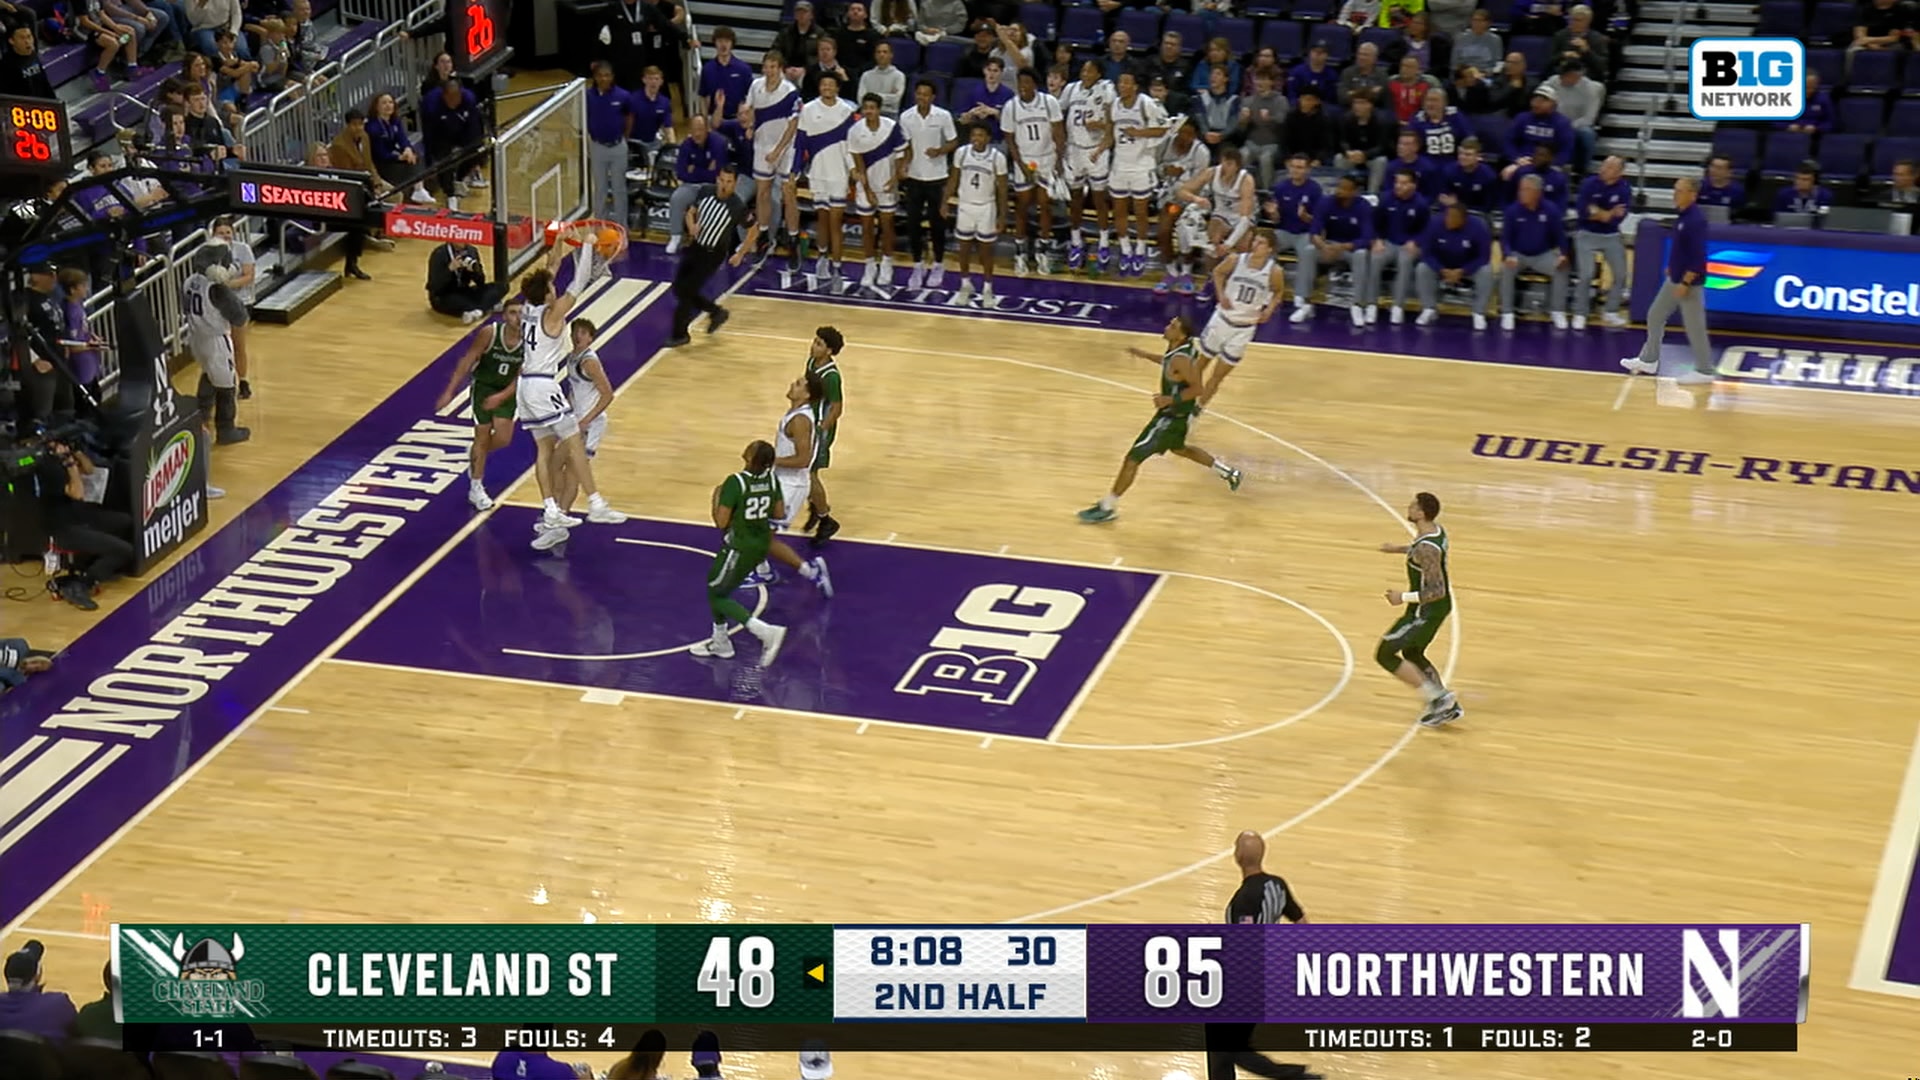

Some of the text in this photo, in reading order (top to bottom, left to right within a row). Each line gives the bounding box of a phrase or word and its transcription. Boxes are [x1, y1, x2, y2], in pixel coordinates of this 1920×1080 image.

[12, 107, 57, 131] 8:08
[15, 130, 50, 160] 26
[1027, 124, 1040, 141] 11
[970, 173, 979, 190] 4
[261, 184, 348, 212] SEATGEEK
[1236, 284, 1256, 304] 10
[154, 353, 168, 393] N
[498, 363, 509, 375] 0
[143, 437, 189, 525] LIBMAN
[745, 495, 771, 520] 22
[143, 491, 200, 558] meijer
